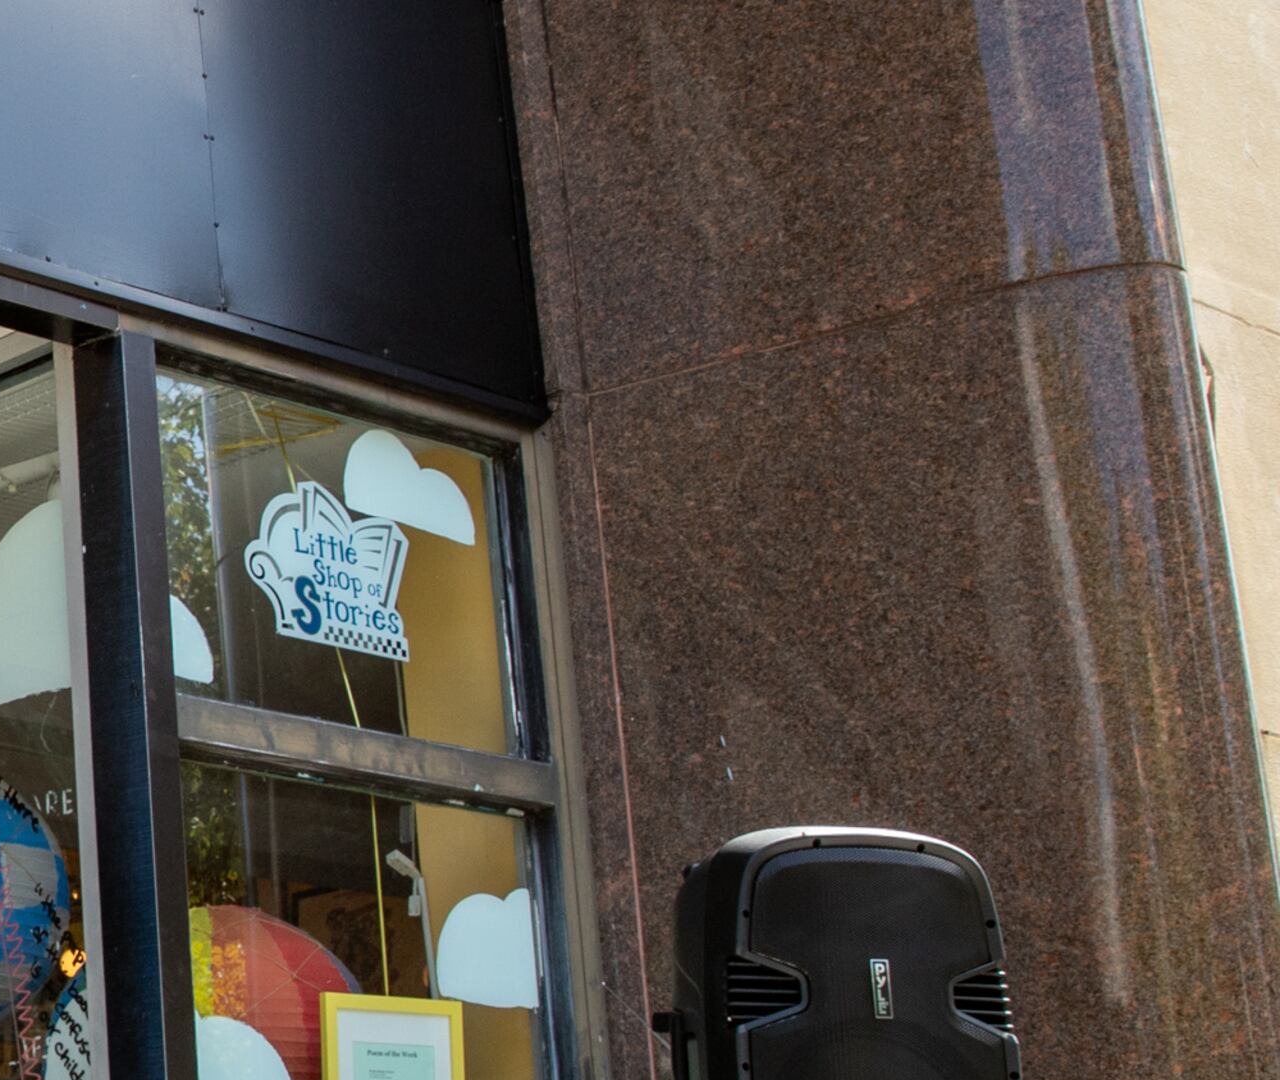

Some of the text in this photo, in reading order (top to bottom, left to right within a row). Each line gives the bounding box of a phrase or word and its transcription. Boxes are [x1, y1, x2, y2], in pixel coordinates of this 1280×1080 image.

[293, 528, 357, 565] Little
[313, 560, 362, 596] Shop
[292, 576, 400, 635] Stories
